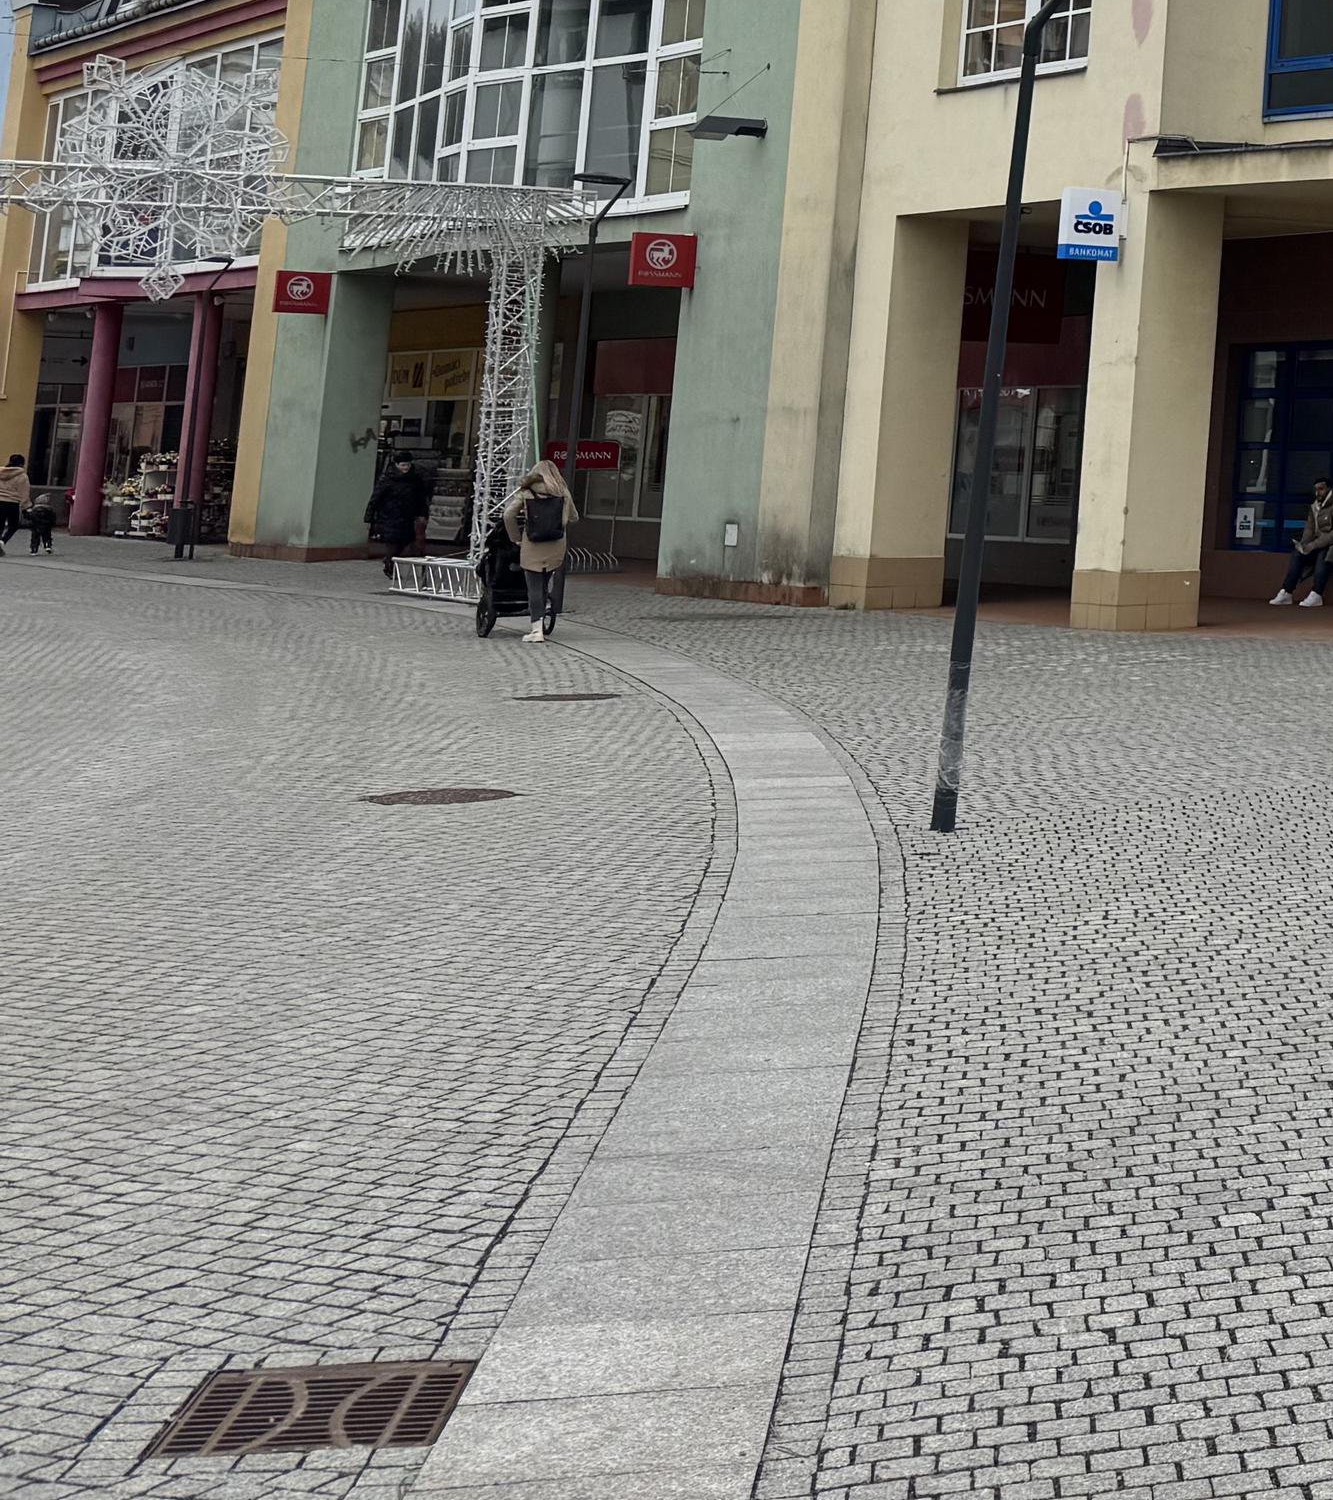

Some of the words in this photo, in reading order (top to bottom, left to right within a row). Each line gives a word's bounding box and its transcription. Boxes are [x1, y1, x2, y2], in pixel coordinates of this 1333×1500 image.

[1073, 220, 1114, 235] ČSOB
[1069, 247, 1113, 258] BANKOMAT
[553, 450, 612, 460] ROSMANN
